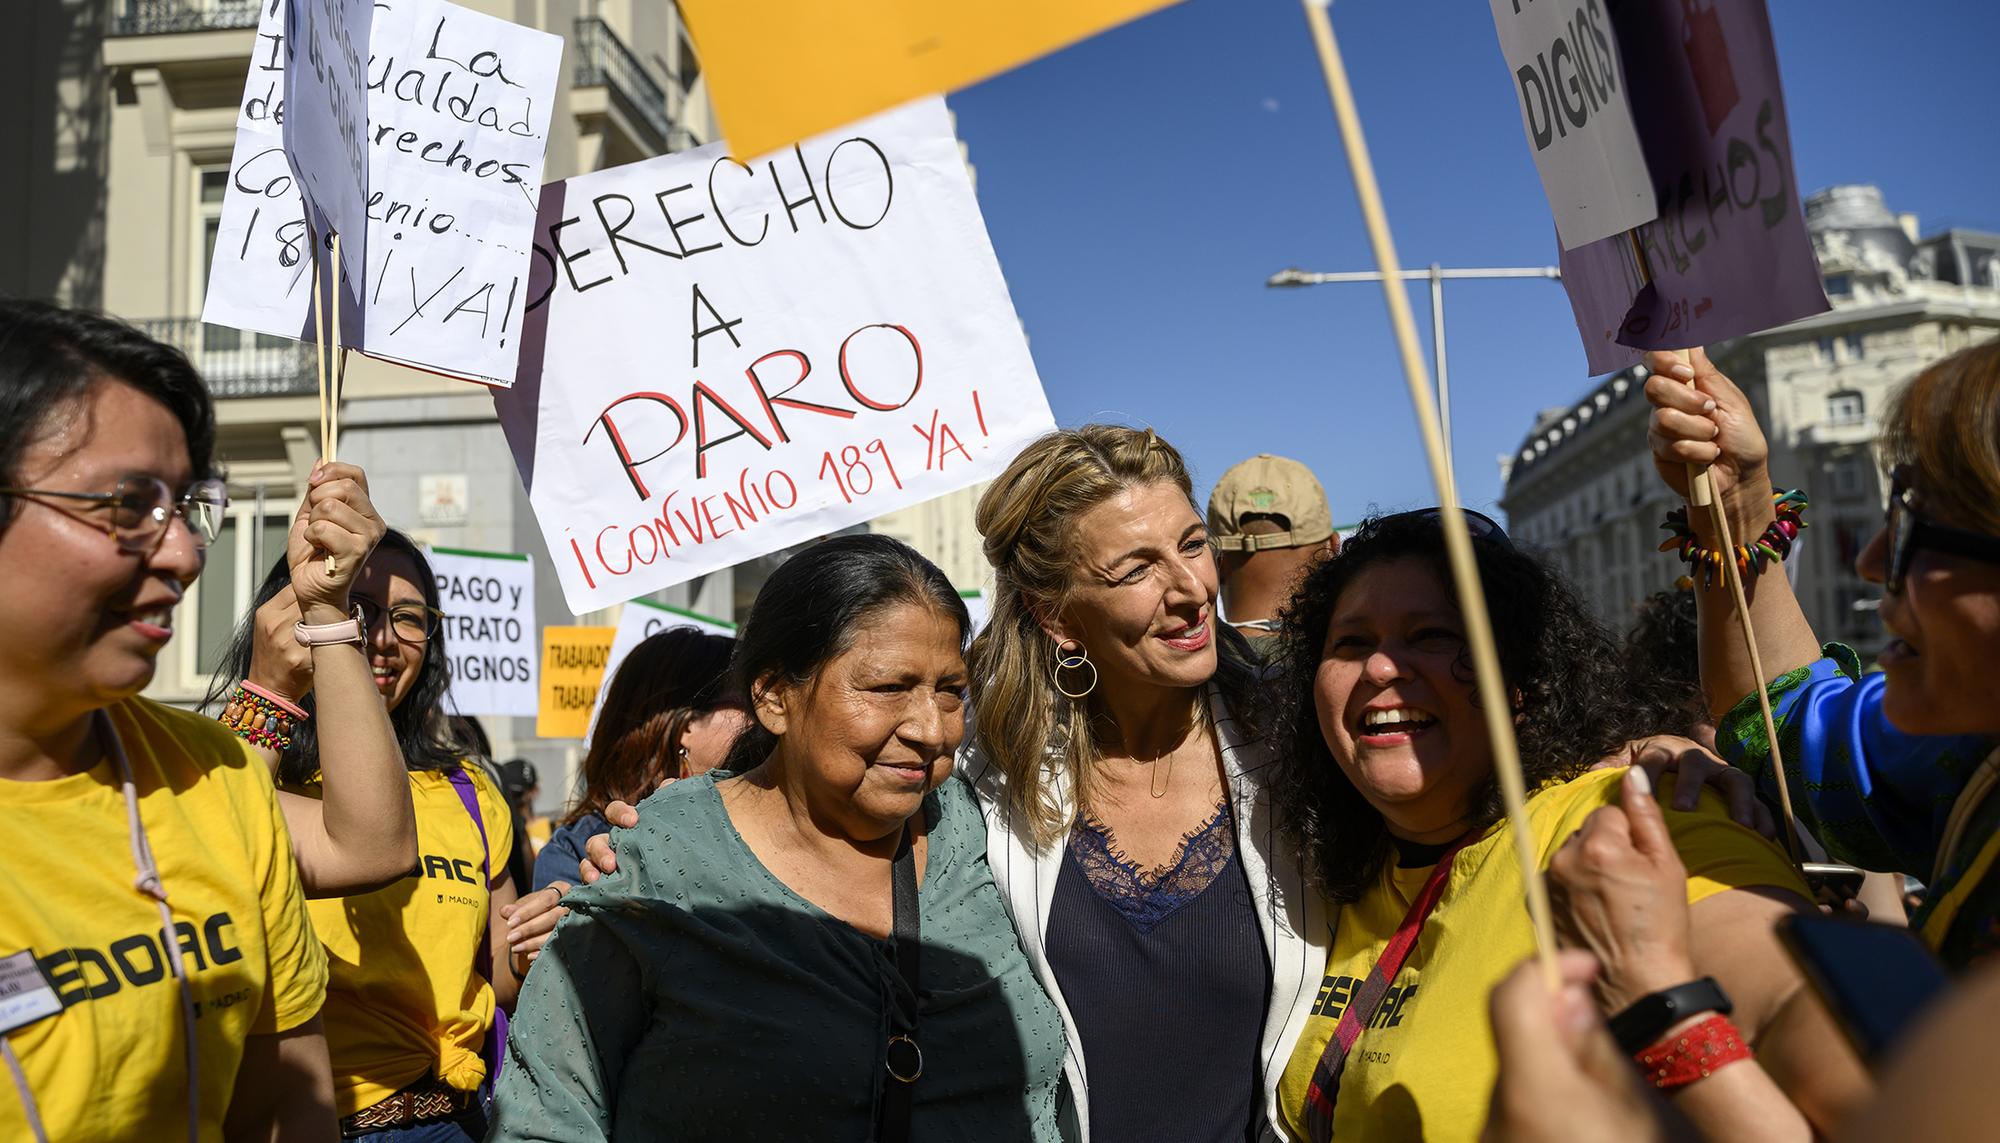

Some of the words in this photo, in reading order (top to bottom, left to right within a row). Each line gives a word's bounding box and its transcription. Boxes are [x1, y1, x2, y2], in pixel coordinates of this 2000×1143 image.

[259, 33, 542, 140] Iualdad.
[426, 16, 526, 89] La
[1516, 0, 1616, 152] DIGNOS
[691, 283, 743, 368] A
[583, 322, 924, 502] PARO
[818, 438, 903, 504] 189
[437, 575, 502, 602] PAGO
[510, 585, 522, 610] y
[444, 616, 522, 643] TRATO
[448, 895, 480, 909] MADRID
[38, 911, 243, 1009] EDOAC
